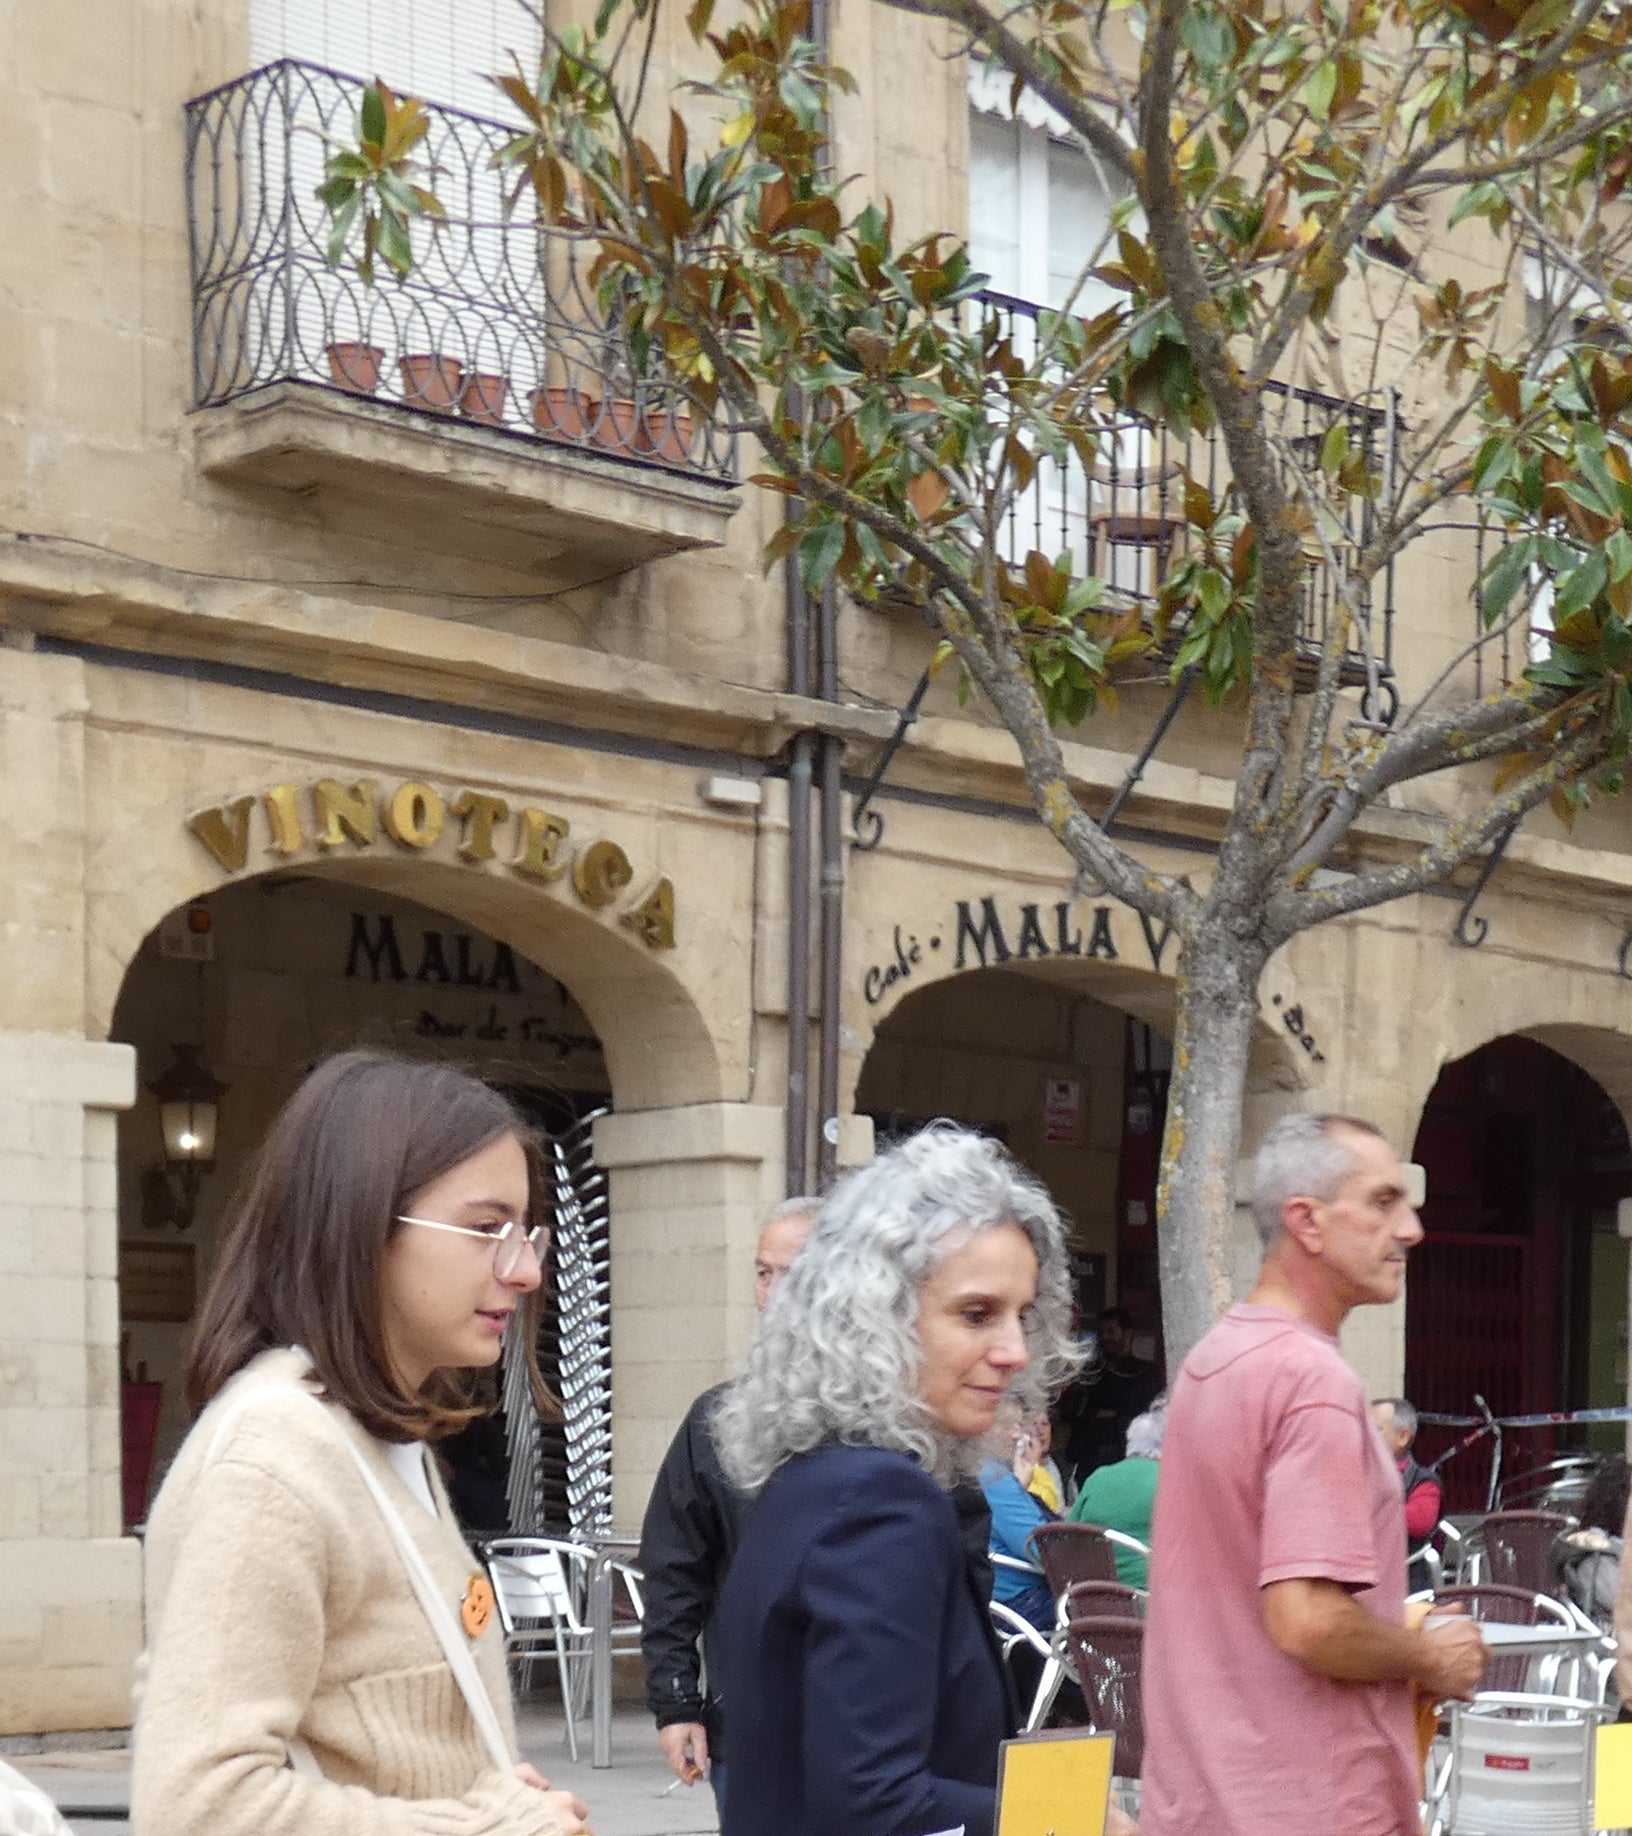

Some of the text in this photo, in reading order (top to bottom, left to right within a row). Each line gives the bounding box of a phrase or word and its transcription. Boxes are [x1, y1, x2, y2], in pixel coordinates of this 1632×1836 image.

[185, 778, 678, 950] VINOTECA
[344, 912, 519, 992] MALA
[865, 925, 922, 1004] Café
[954, 897, 1120, 970] MALA
[1282, 1004, 1325, 1063] Bar
